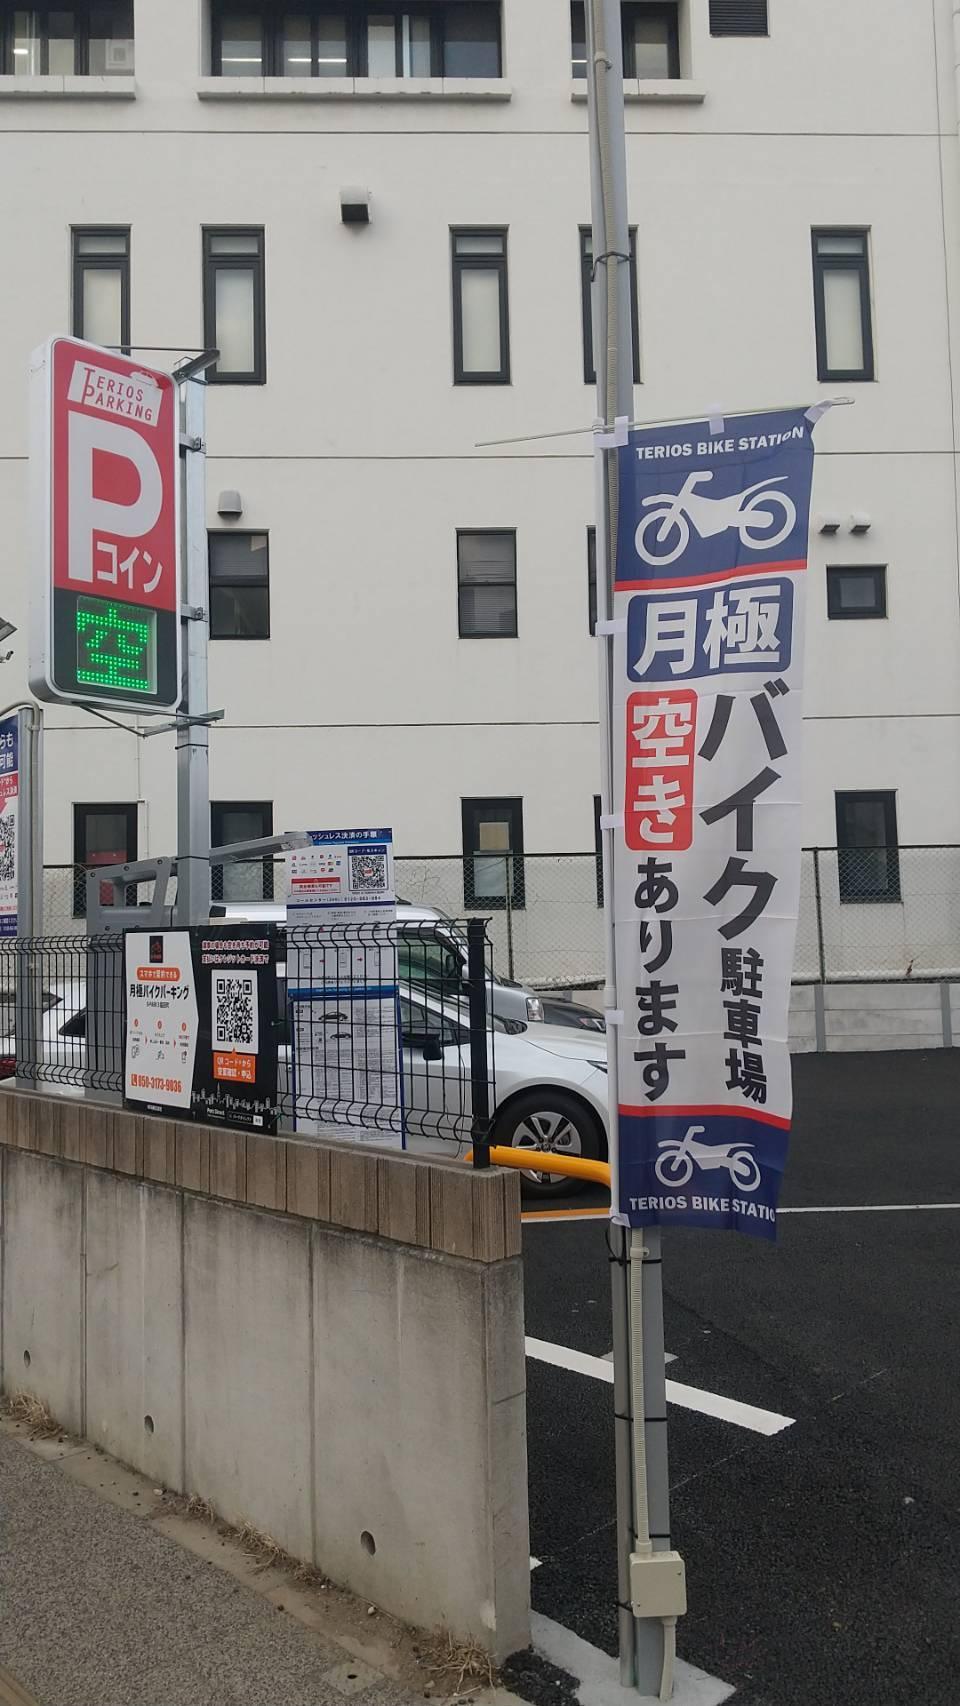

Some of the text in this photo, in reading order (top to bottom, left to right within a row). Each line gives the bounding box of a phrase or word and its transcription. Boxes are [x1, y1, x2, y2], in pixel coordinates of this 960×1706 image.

[84, 367, 145, 402] TERIOS
[82, 384, 154, 422] PARKING
[636, 426, 805, 460] TERIOS BIKE STATION
[68, 410, 163, 583] P
[97, 541, 163, 594] コイン
[76, 605, 149, 690] 空
[633, 584, 782, 677] 月極
[310, 830, 377, 841] ッシュレス決済の手順
[129, 984, 190, 1000] 月極バイクパーキング
[629, 1194, 776, 1223] TERIOS BIKE STATIO
